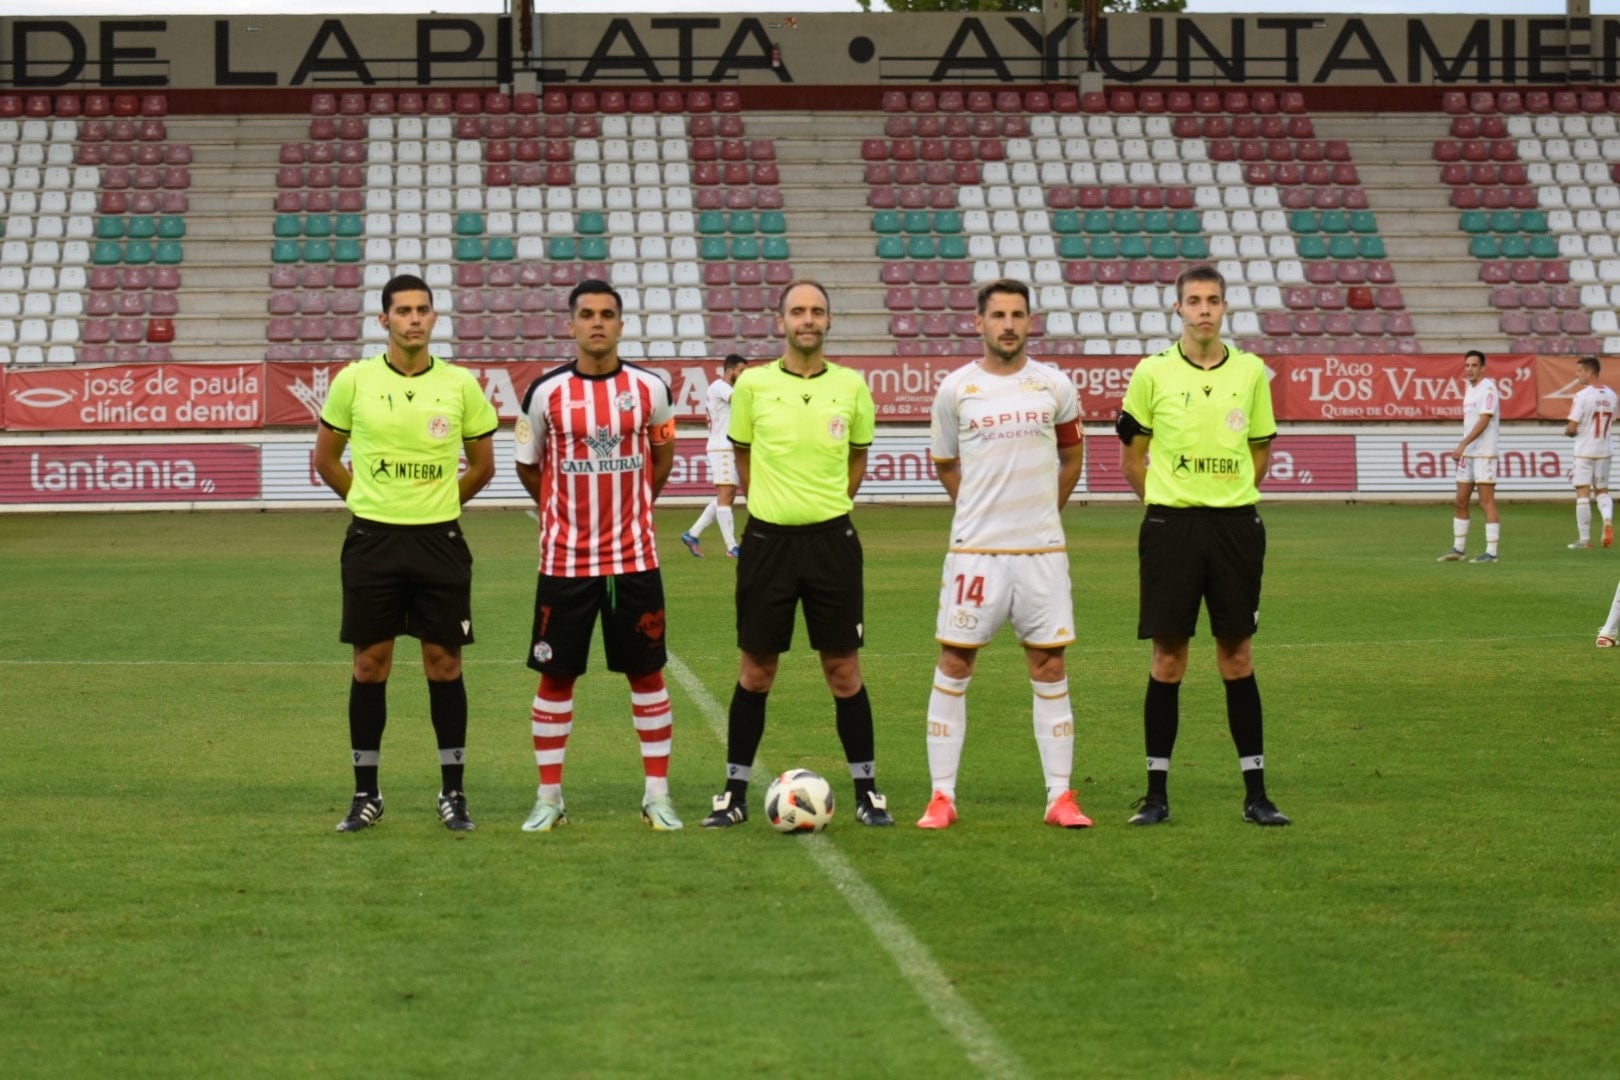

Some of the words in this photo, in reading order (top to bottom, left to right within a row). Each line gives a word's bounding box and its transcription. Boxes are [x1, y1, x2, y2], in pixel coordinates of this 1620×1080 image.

[13, 21, 168, 87] DE
[215, 20, 376, 86] LA
[417, 17, 793, 85] PLATA
[1325, 358, 1373, 377] PAGO
[83, 372, 134, 401] josé
[145, 369, 178, 396] de
[190, 368, 258, 399] paula
[80, 400, 167, 423] clínica
[176, 401, 258, 422] dental
[882, 404, 896, 414] 69
[898, 404, 911, 414] 52
[1321, 403, 1363, 418] QUESO
[1366, 406, 1382, 416] DE
[1384, 403, 1422, 416] OVEJA
[969, 410, 1050, 430] ASPIRE
[1592, 411, 1613, 439] 17
[982, 429, 1041, 441] ACADEMY
[31, 453, 196, 491] lantania
[395, 462, 442, 479] INTEGRA
[561, 460, 594, 473] CAJA
[599, 456, 643, 472] RURAL
[1194, 457, 1240, 474] INTEGRA
[955, 573, 985, 608] 14
